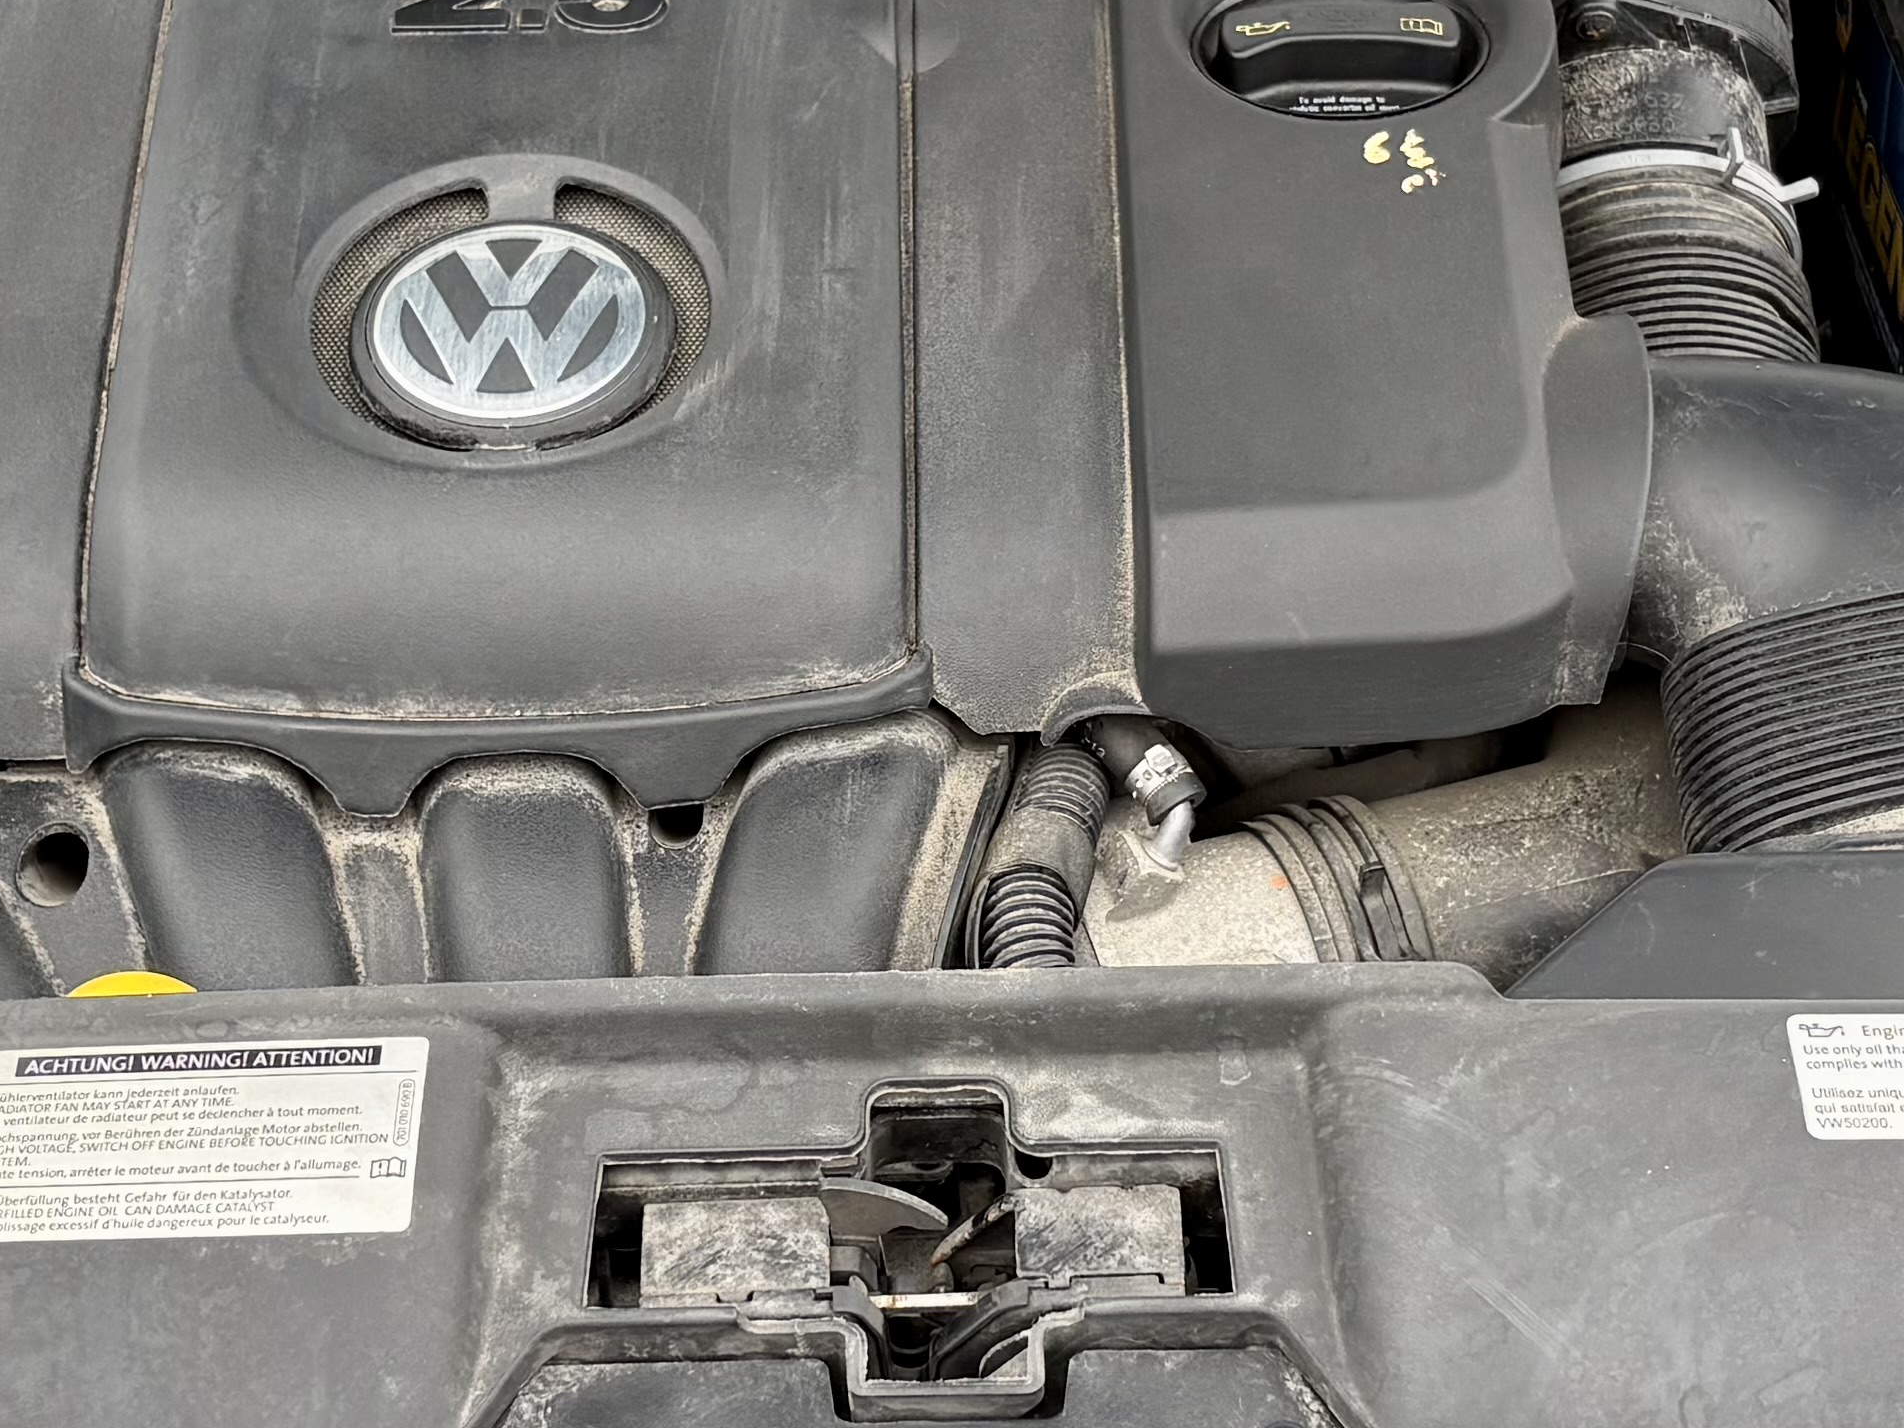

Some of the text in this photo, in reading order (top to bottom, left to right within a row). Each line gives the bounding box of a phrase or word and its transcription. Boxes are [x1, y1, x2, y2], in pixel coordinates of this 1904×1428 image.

[1802, 1044, 1829, 1055] Use
[1832, 1044, 1862, 1057] only
[1865, 1043, 1883, 1054] oil
[24, 1048, 374, 1075] ACHTUNG! WARNING! ATTENTION!
[1806, 1058, 1868, 1072] complies
[1870, 1058, 1903, 1069] with
[94, 1089, 123, 1099] kann
[126, 1088, 179, 1102] jederzeit
[182, 1085, 240, 1096] anlaufen.
[1810, 1087, 1864, 1099] Utilisez
[54, 1102, 80, 1112] FAN
[82, 1101, 111, 1111] MAY
[114, 1099, 151, 1110] START
[154, 1099, 170, 1108] AT
[172, 1098, 199, 1108] ANY
[201, 1097, 234, 1107] TIME.
[1814, 1102, 1837, 1116] qui
[1841, 1102, 1896, 1114] satisfait
[3, 1114, 70, 1126] ventilateur
[72, 1113, 88, 1124] de
[91, 1111, 148, 1123] radiateur
[150, 1111, 179, 1123] peut
[182, 1111, 195, 1120] se
[266, 1106, 275, 1117] à
[277, 1105, 304, 1117] tout
[307, 1105, 363, 1116] moment.
[82, 1131, 101, 1141] vor
[104, 1128, 161, 1139] Berühren
[164, 1127, 185, 1138] der
[187, 1125, 260, 1137] Zündanlage
[262, 1123, 301, 1134] Motor
[303, 1122, 363, 1133] abstellen.
[18, 1144, 77, 1154] VOLTAGE,
[79, 1142, 128, 1153] SWITCH
[131, 1141, 155, 1151] OFF
[158, 1139, 206, 1150] ENGINE
[209, 1137, 256, 1149] BEFORE
[259, 1136, 327, 1147] TOUCHING
[330, 1133, 389, 1145] IGNITION
[18, 1168, 67, 1179] tension,
[69, 1166, 111, 1177] arrêter
[114, 1165, 126, 1175] le
[128, 1165, 175, 1175] moteur
[177, 1164, 212, 1174] avant
[214, 1163, 230, 1172] de
[233, 1161, 281, 1172] toucher
[284, 1160, 291, 1170] à
[294, 1159, 361, 1171] l'allumage.
[73, 1193, 120, 1204] besteht
[124, 1191, 167, 1203] Gefahr
[172, 1190, 191, 1202] für
[194, 1190, 217, 1201] den
[220, 1188, 293, 1202] Katalysator.
[46, 1206, 94, 1218] ENGINE
[98, 1205, 118, 1216] OIL
[124, 1204, 152, 1216] CAN
[155, 1202, 212, 1215] DAMAGE
[215, 1201, 275, 1213] CATALYST
[48, 1219, 98, 1230] excessif
[101, 1218, 144, 1230] d'huile
[147, 1218, 214, 1230] dangereux
[217, 1217, 246, 1229] pour
[249, 1215, 261, 1226] le
[263, 1213, 329, 1227] catalyseur.
